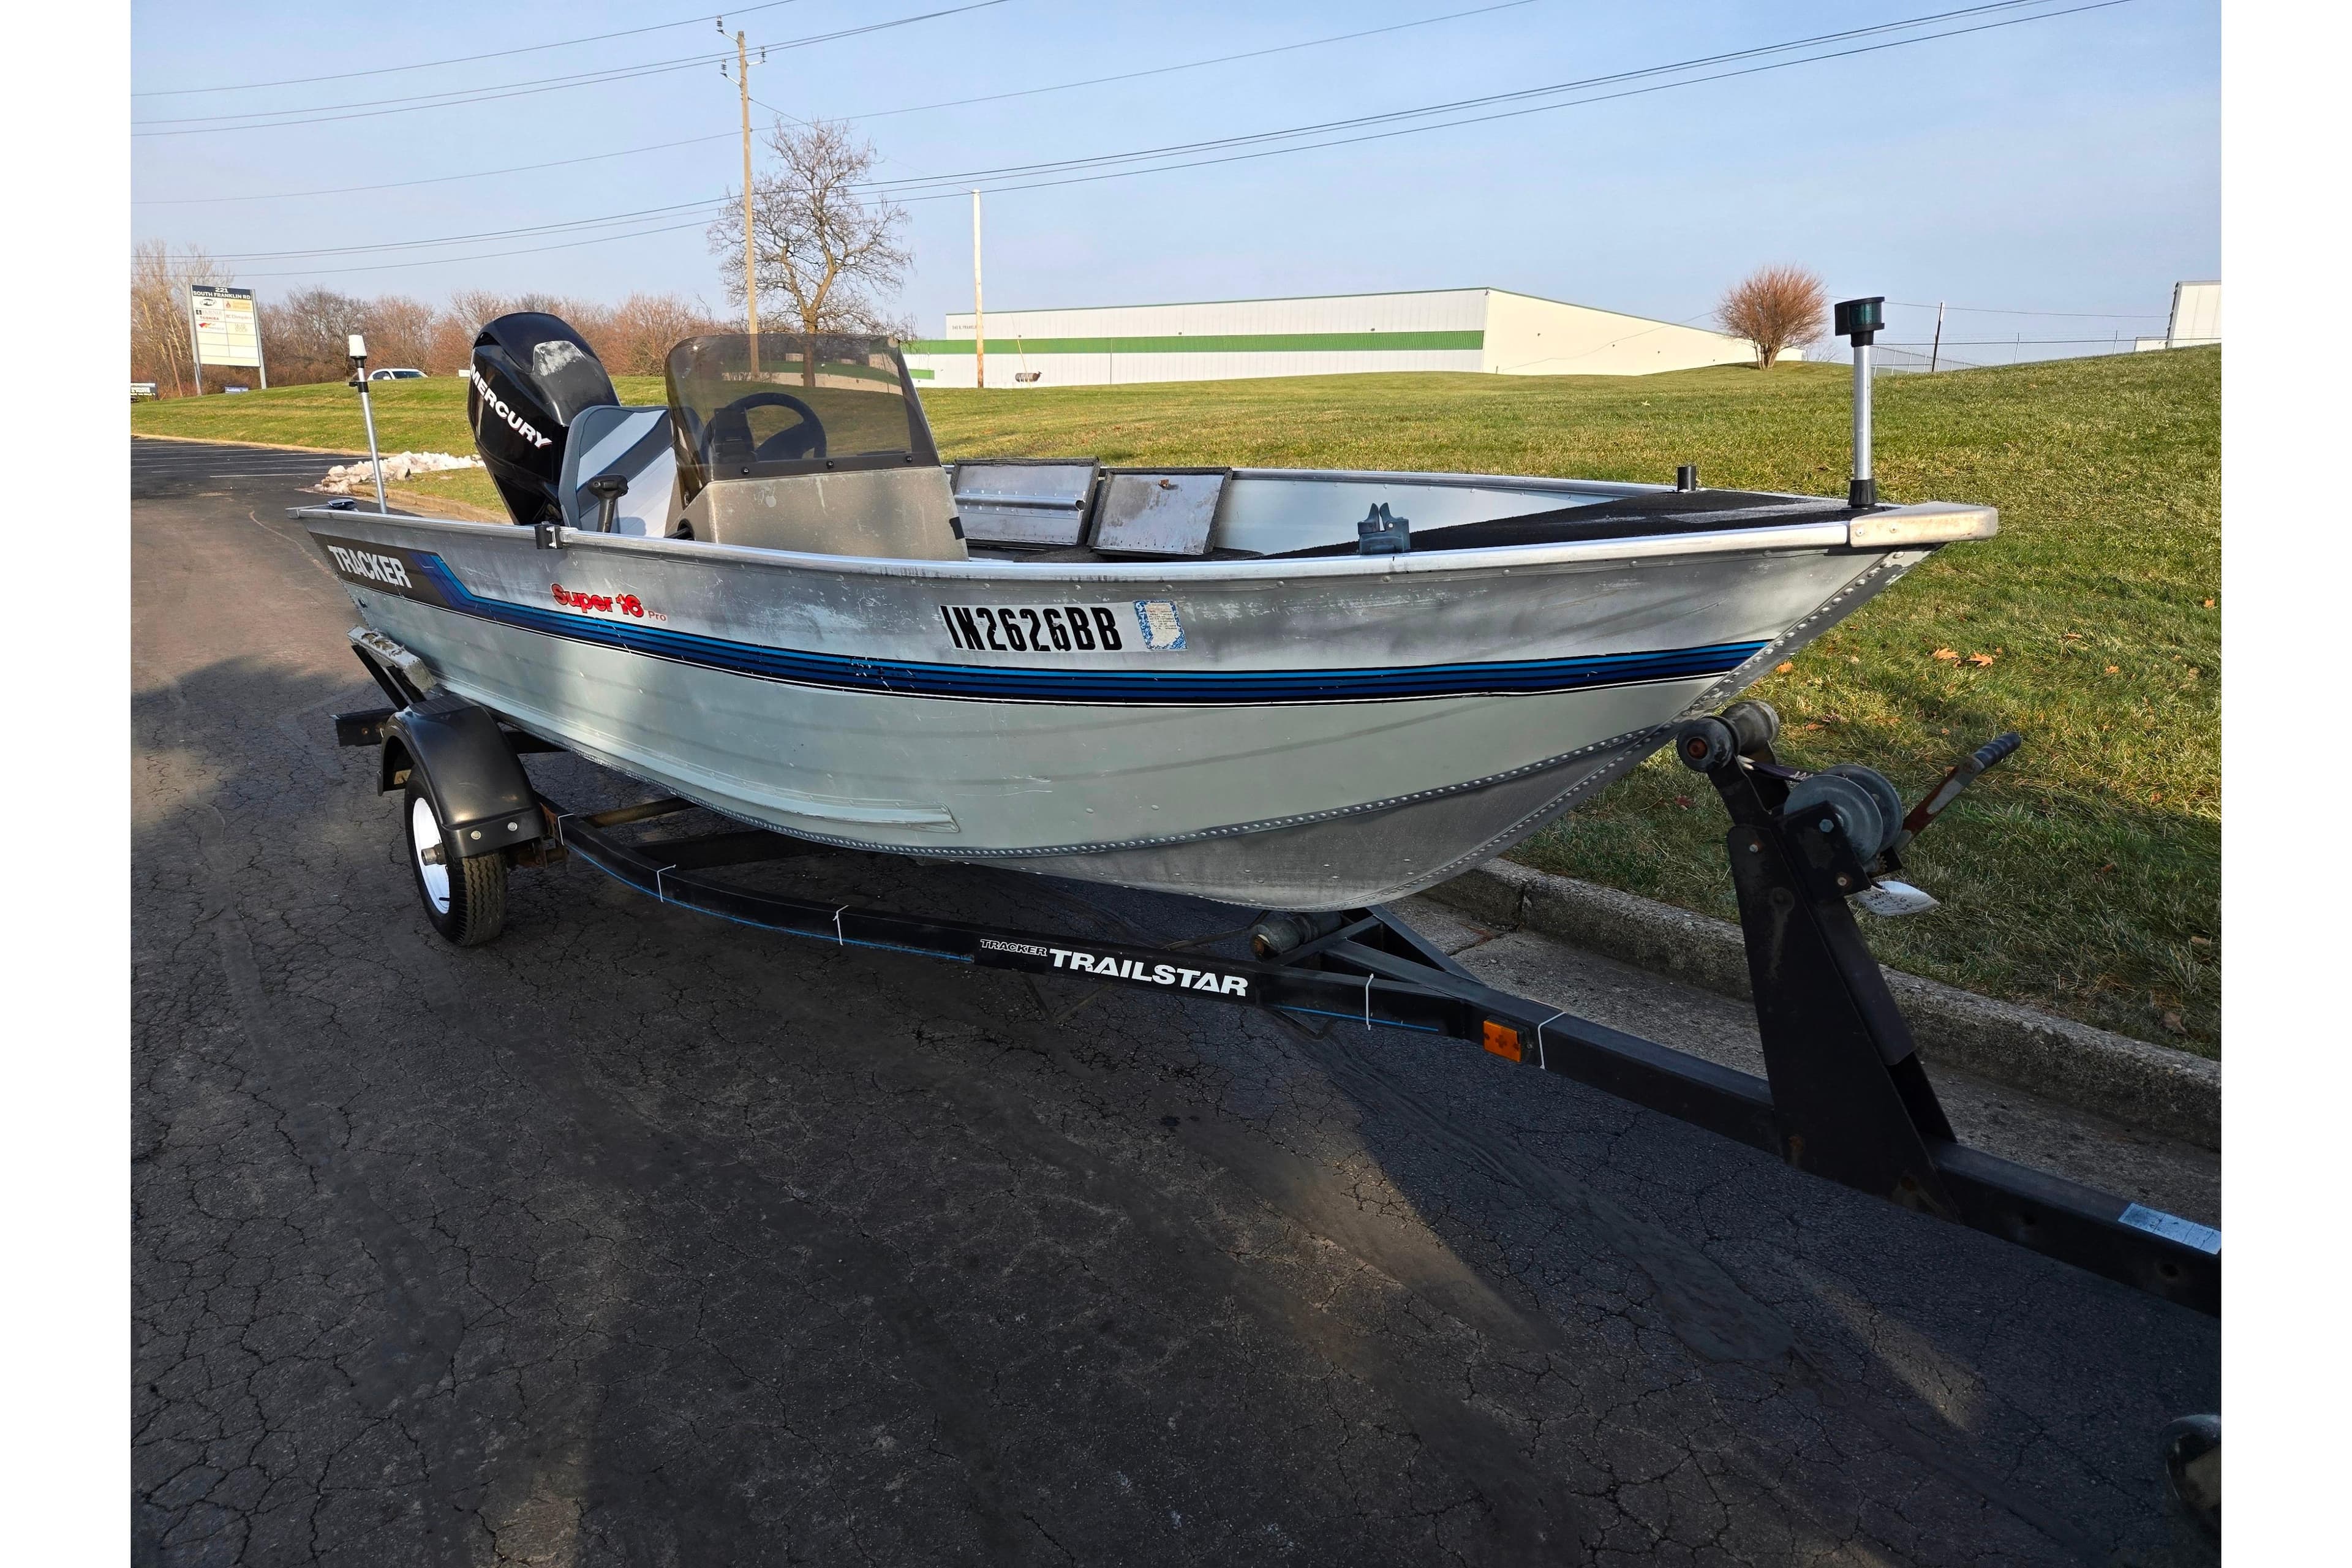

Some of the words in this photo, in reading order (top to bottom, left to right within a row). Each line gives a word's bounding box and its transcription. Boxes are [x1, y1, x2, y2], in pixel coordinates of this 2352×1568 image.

[470, 364, 552, 449] MERCURY
[327, 545, 412, 588] TRACKER
[551, 583, 613, 613] Super
[615, 594, 644, 618] 16
[648, 611, 666, 622] Pro
[980, 939, 1047, 956] TRACKER
[1049, 949, 1249, 997] TRAILSTAR
